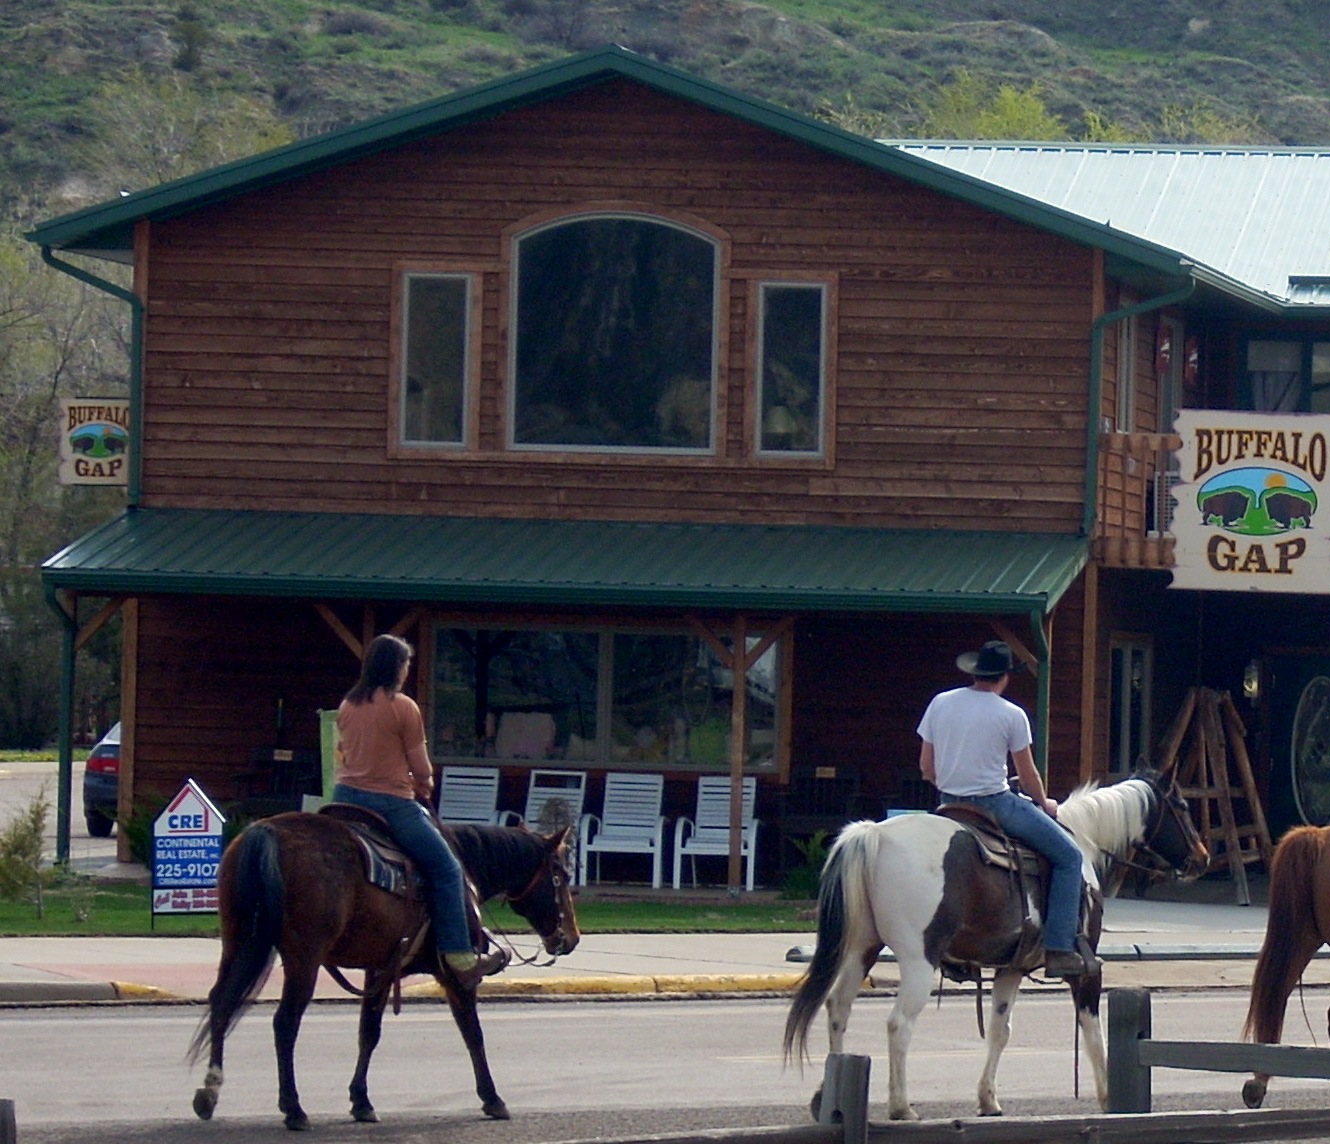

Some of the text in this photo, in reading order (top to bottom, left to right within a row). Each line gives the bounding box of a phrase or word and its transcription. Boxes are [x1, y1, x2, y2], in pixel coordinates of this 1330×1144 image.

[1193, 428, 1327, 482] BUFFALO
[75, 458, 122, 477] GAP
[1207, 534, 1306, 574] GAP
[168, 814, 203, 829] CRE
[156, 838, 219, 848] CONTINENTAL
[156, 850, 177, 859] REAL
[156, 863, 219, 877] 225-9107
